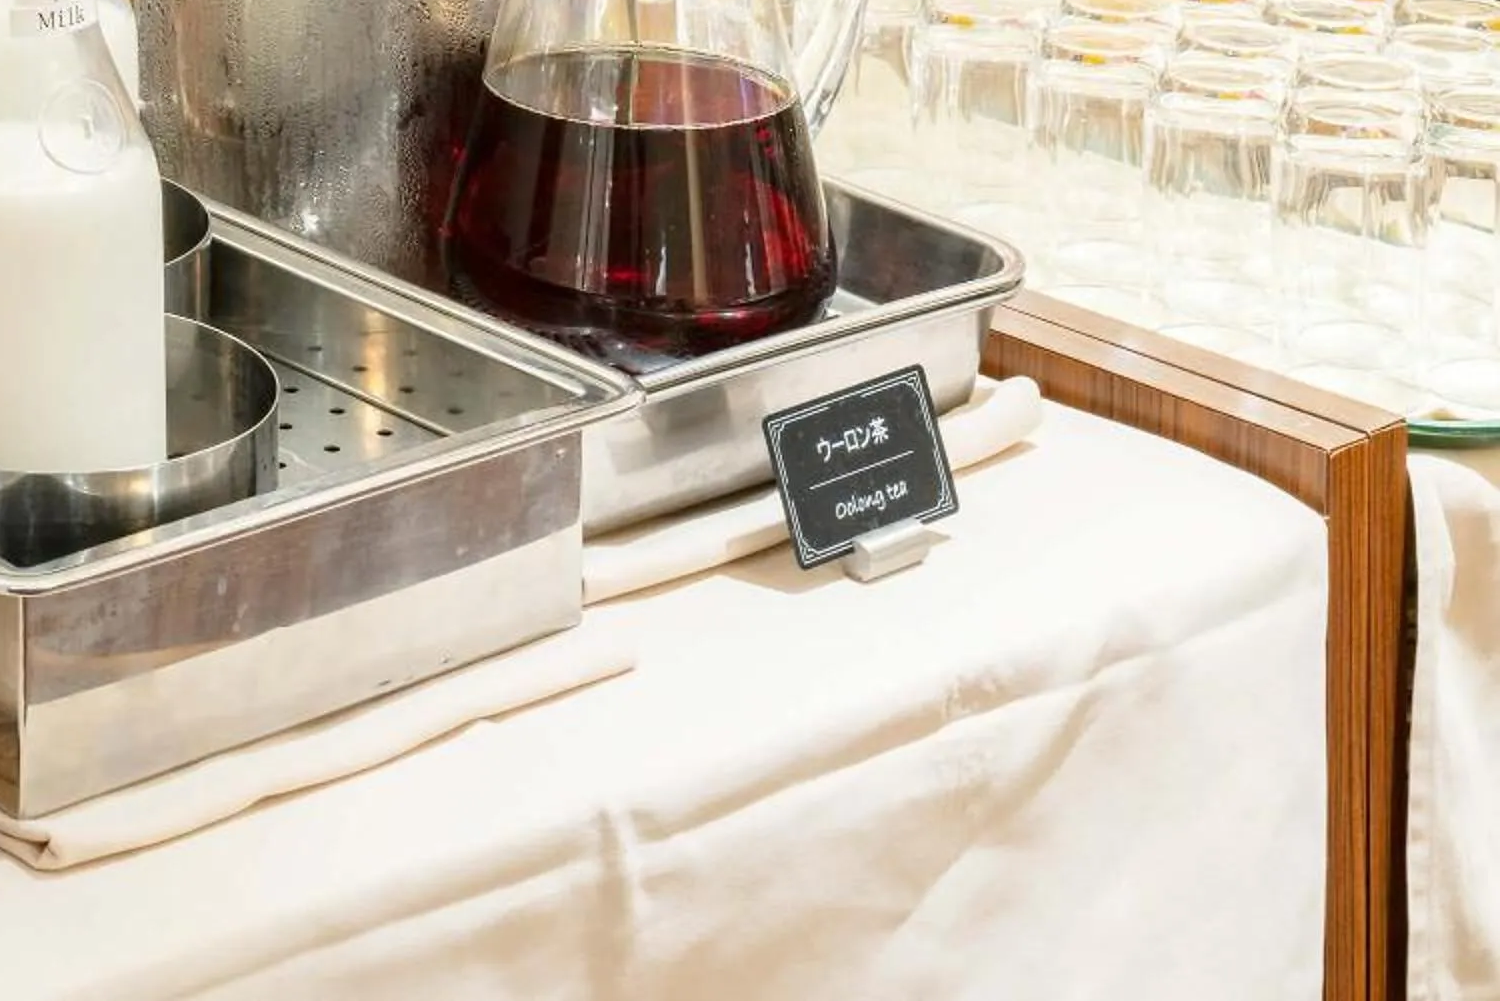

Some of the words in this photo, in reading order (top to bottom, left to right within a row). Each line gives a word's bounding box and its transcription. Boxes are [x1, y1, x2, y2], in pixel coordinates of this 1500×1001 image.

[37, 5, 85, 30] Milk
[817, 416, 890, 463] ウーロン茶
